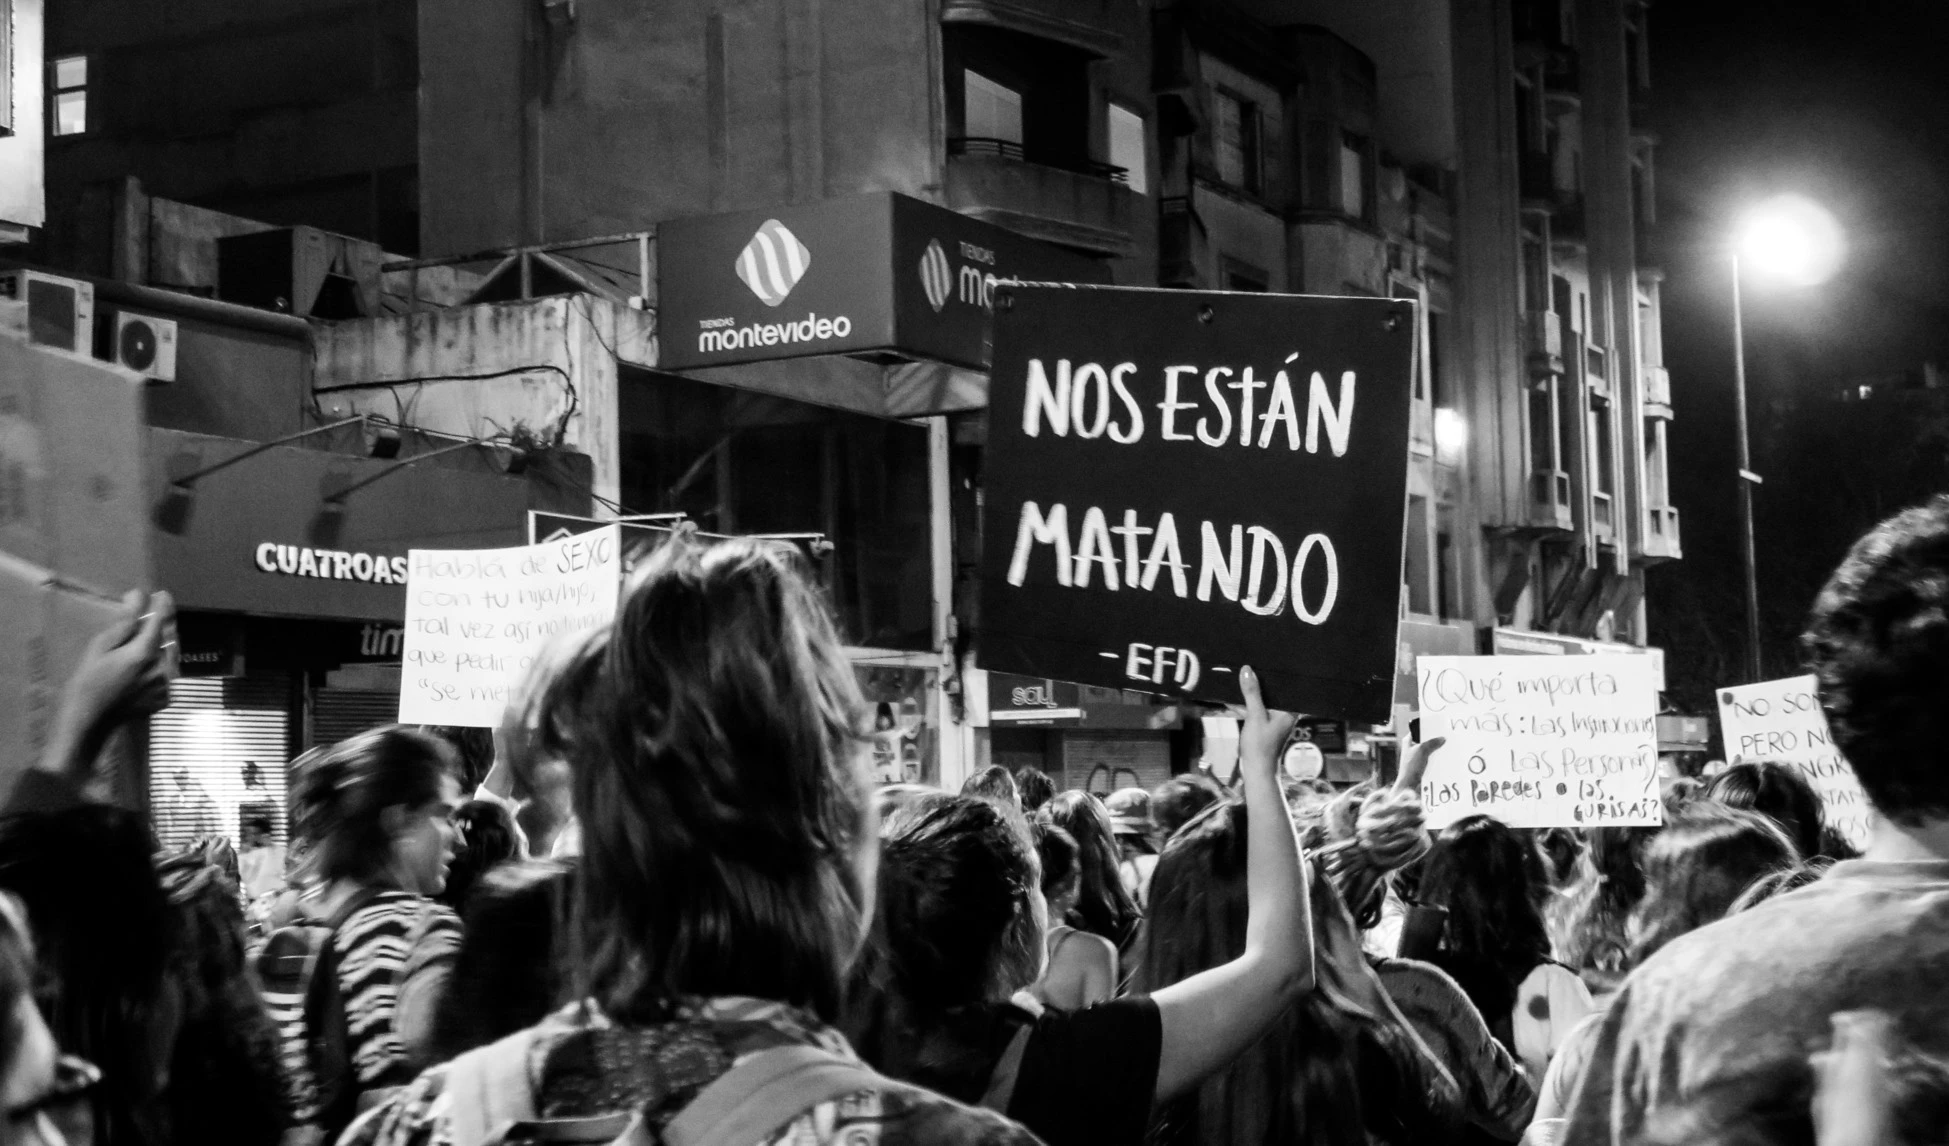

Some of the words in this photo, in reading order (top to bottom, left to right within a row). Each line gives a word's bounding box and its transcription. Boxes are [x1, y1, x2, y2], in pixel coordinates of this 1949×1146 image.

[699, 312, 851, 352] montevideo
[1022, 358, 1144, 444] NOS
[256, 542, 409, 584] CUATROAS
[415, 555, 507, 579] Hablá
[520, 555, 547, 577] de
[557, 537, 611, 574] SEXO
[1006, 501, 1338, 625] MATANDO
[417, 589, 472, 607] con
[484, 591, 510, 608] tu
[459, 621, 496, 639] vez
[407, 650, 447, 668] que
[1422, 668, 1506, 712] ¿Qué
[1517, 671, 1618, 707] importa
[1734, 698, 1771, 718] NO
[1740, 730, 1798, 756] PERO
